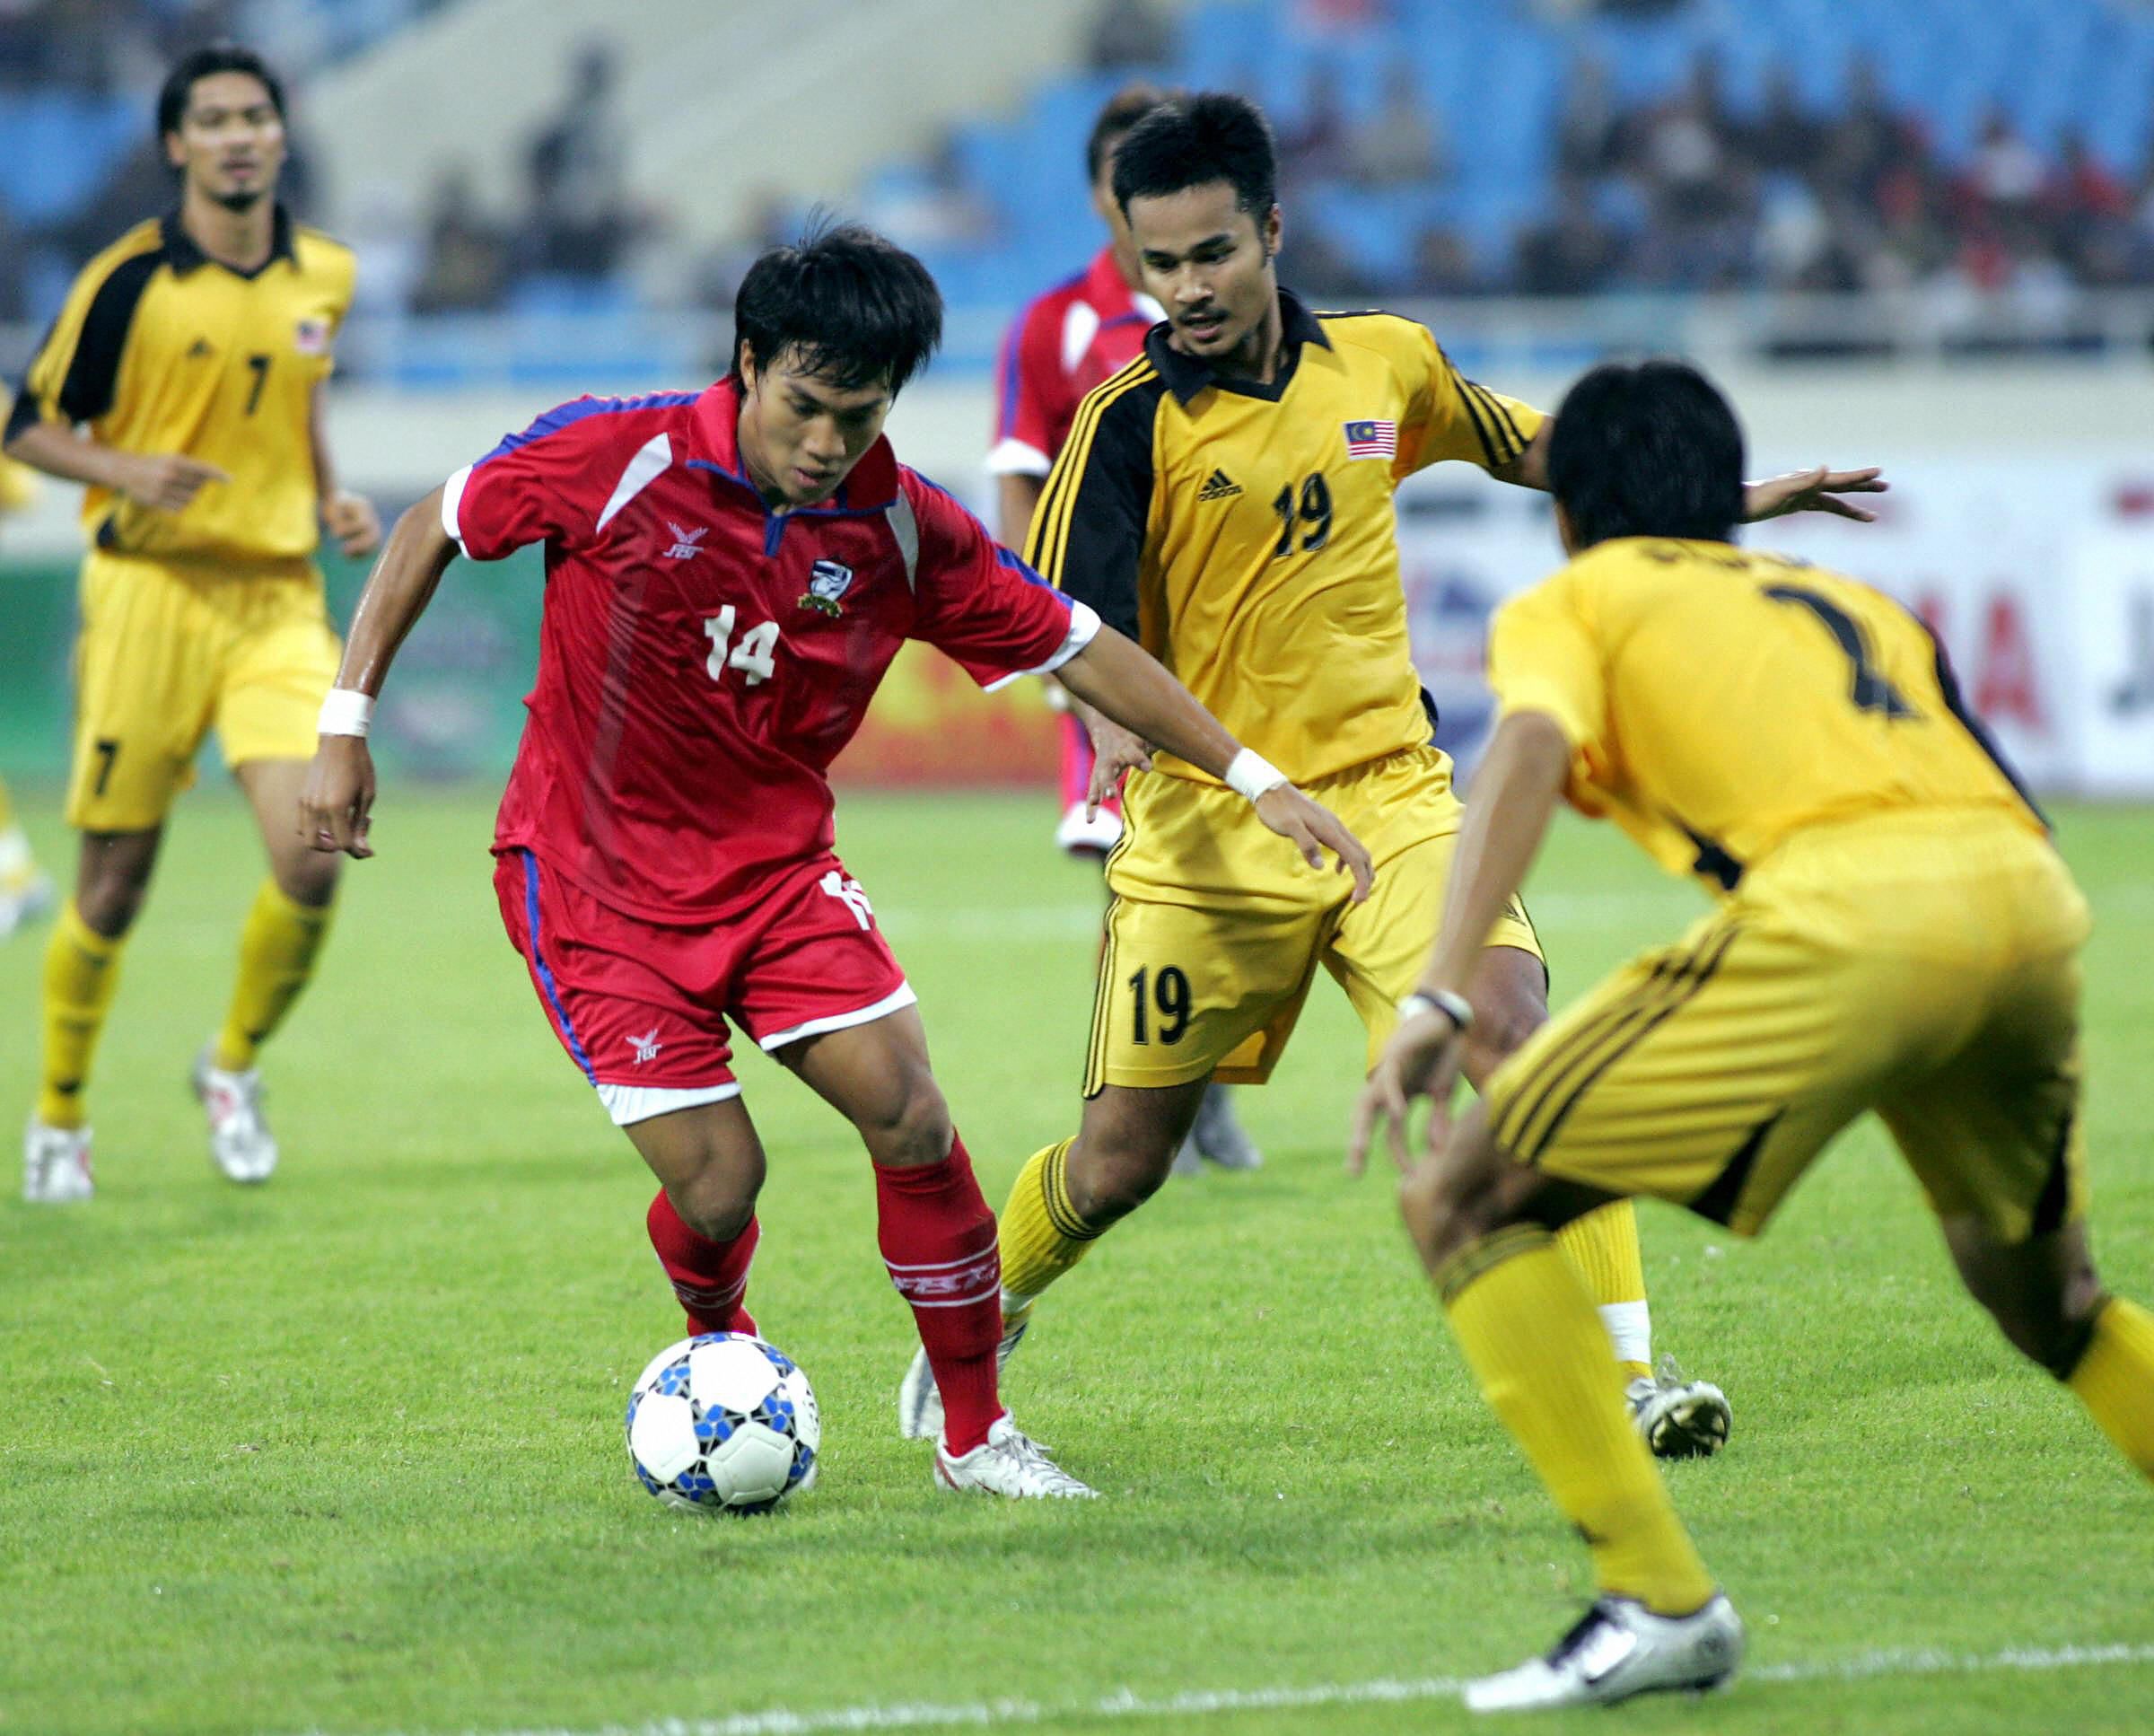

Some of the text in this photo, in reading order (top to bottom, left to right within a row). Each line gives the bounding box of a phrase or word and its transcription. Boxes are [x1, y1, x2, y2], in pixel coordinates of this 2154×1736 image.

[248, 355, 272, 416] 7
[1272, 472, 1332, 560] 19
[705, 604, 780, 686] 14
[94, 740, 120, 797] 7
[1128, 963, 1191, 1046] 19
